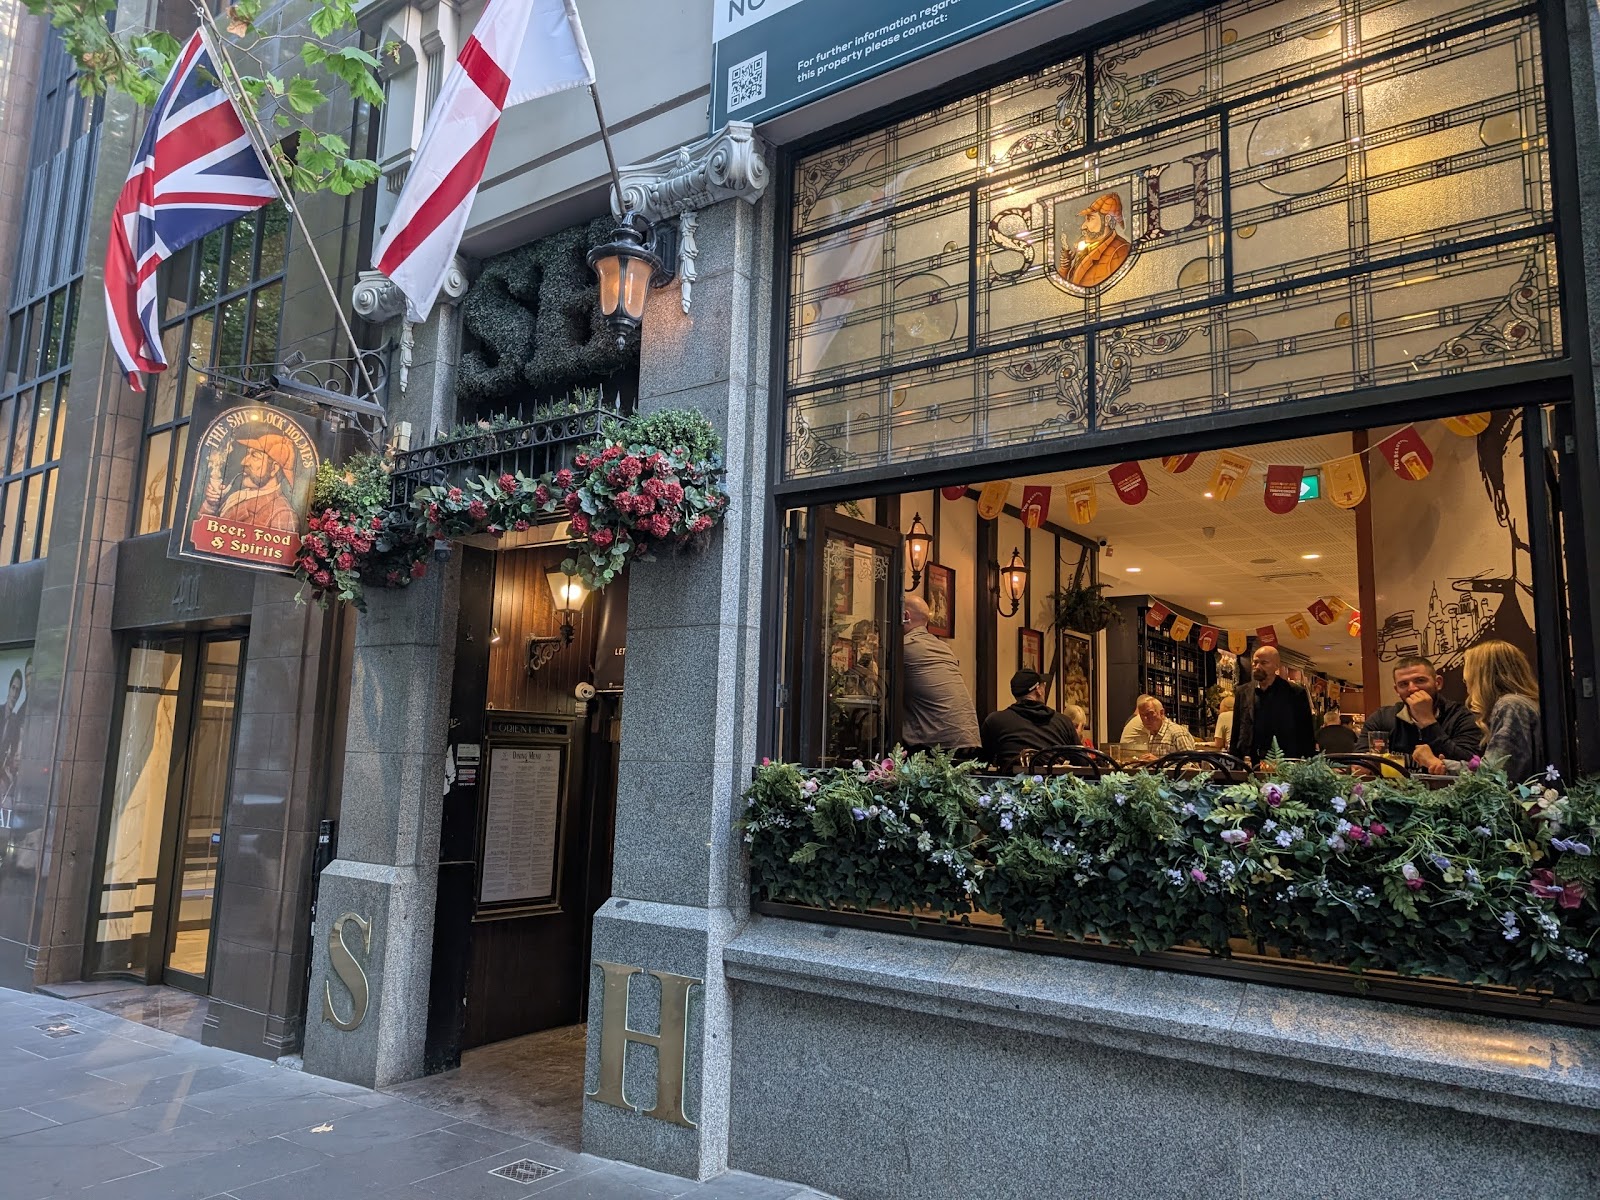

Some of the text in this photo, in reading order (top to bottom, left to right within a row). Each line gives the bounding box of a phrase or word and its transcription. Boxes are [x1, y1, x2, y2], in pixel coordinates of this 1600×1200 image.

[797, 58, 814, 71] For
[816, 40, 853, 62] further
[854, 13, 917, 46] information
[797, 14, 948, 83] this property please contact:
[205, 410, 314, 469] THE SHELOCK HOLMES
[206, 520, 291, 546] Beer, Food
[211, 536, 283, 559] & Spirits
[322, 912, 372, 1031] S
[586, 959, 703, 1129] H
